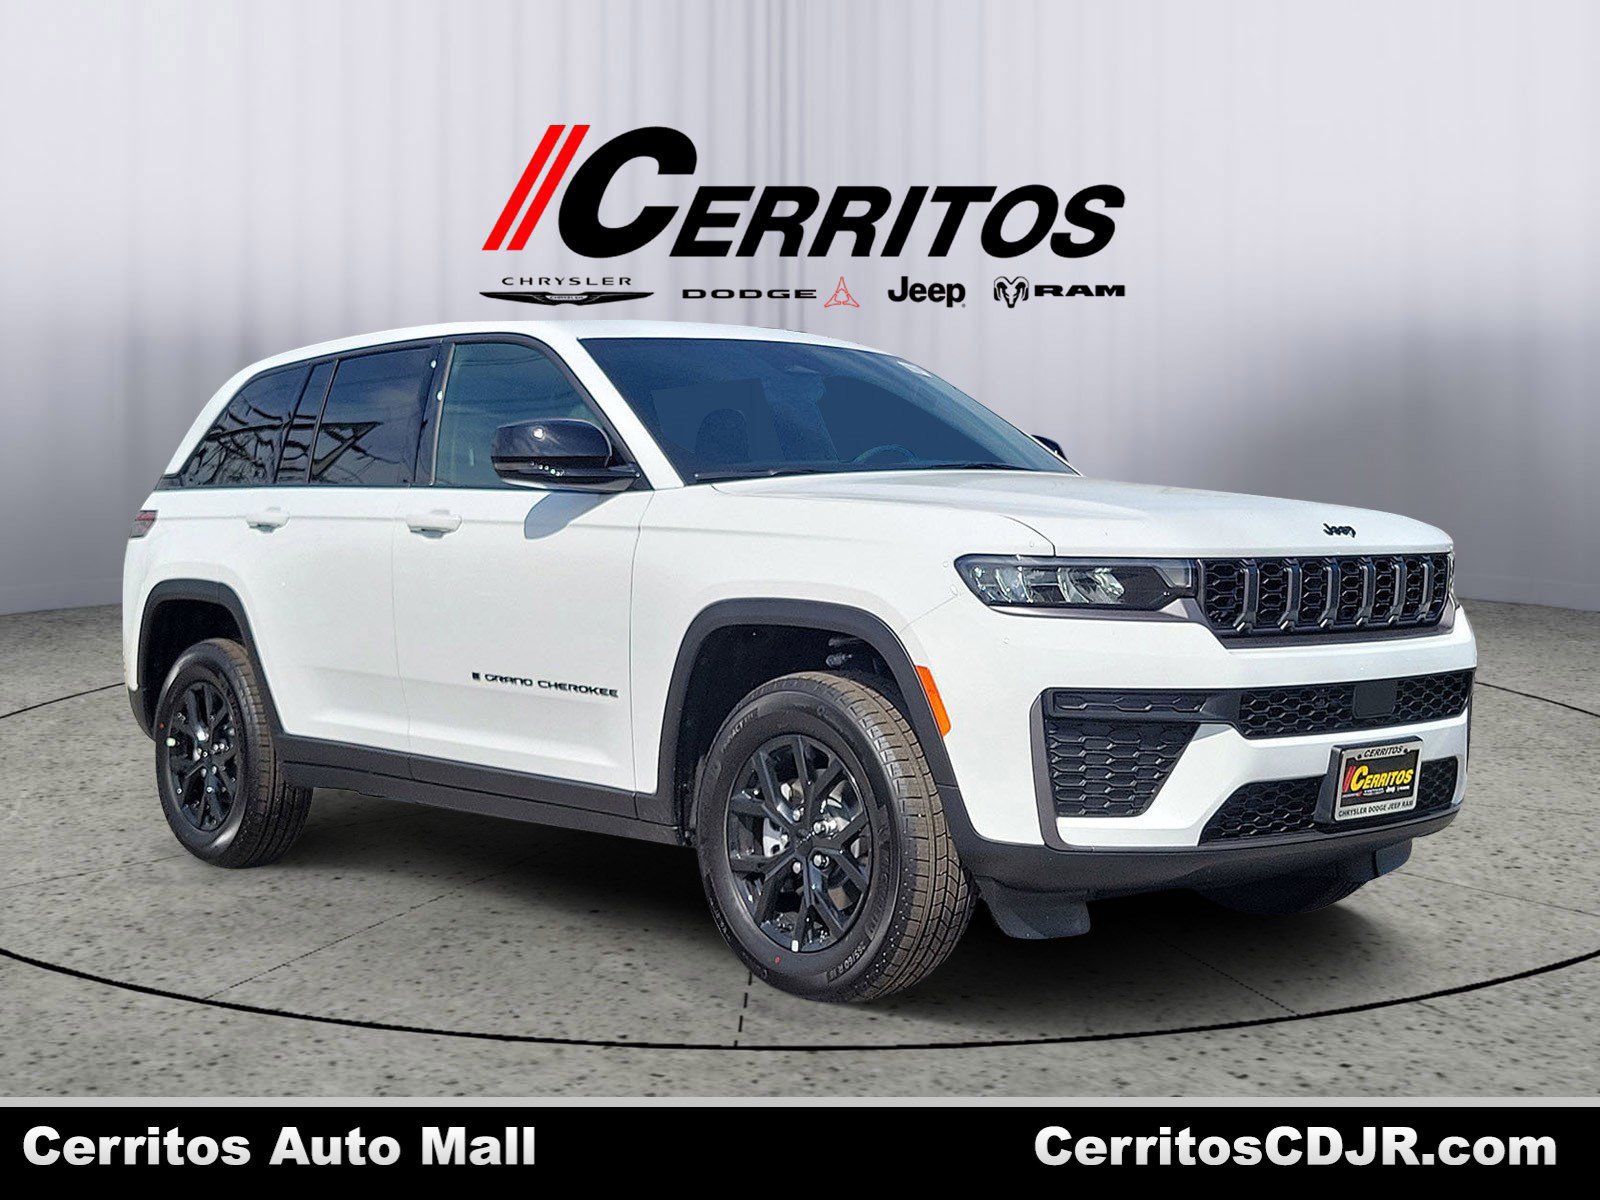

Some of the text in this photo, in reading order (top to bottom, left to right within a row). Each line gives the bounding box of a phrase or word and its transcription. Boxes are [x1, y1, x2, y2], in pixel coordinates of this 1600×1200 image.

[1322, 522, 1357, 538] Jeep
[484, 673, 619, 698] GRAND CHEROKEE
[1363, 745, 1404, 758] CERRITOS
[1350, 765, 1414, 792] CERRITOS
[1338, 800, 1414, 818] CHRYSLER DODGE JEEP RAM
